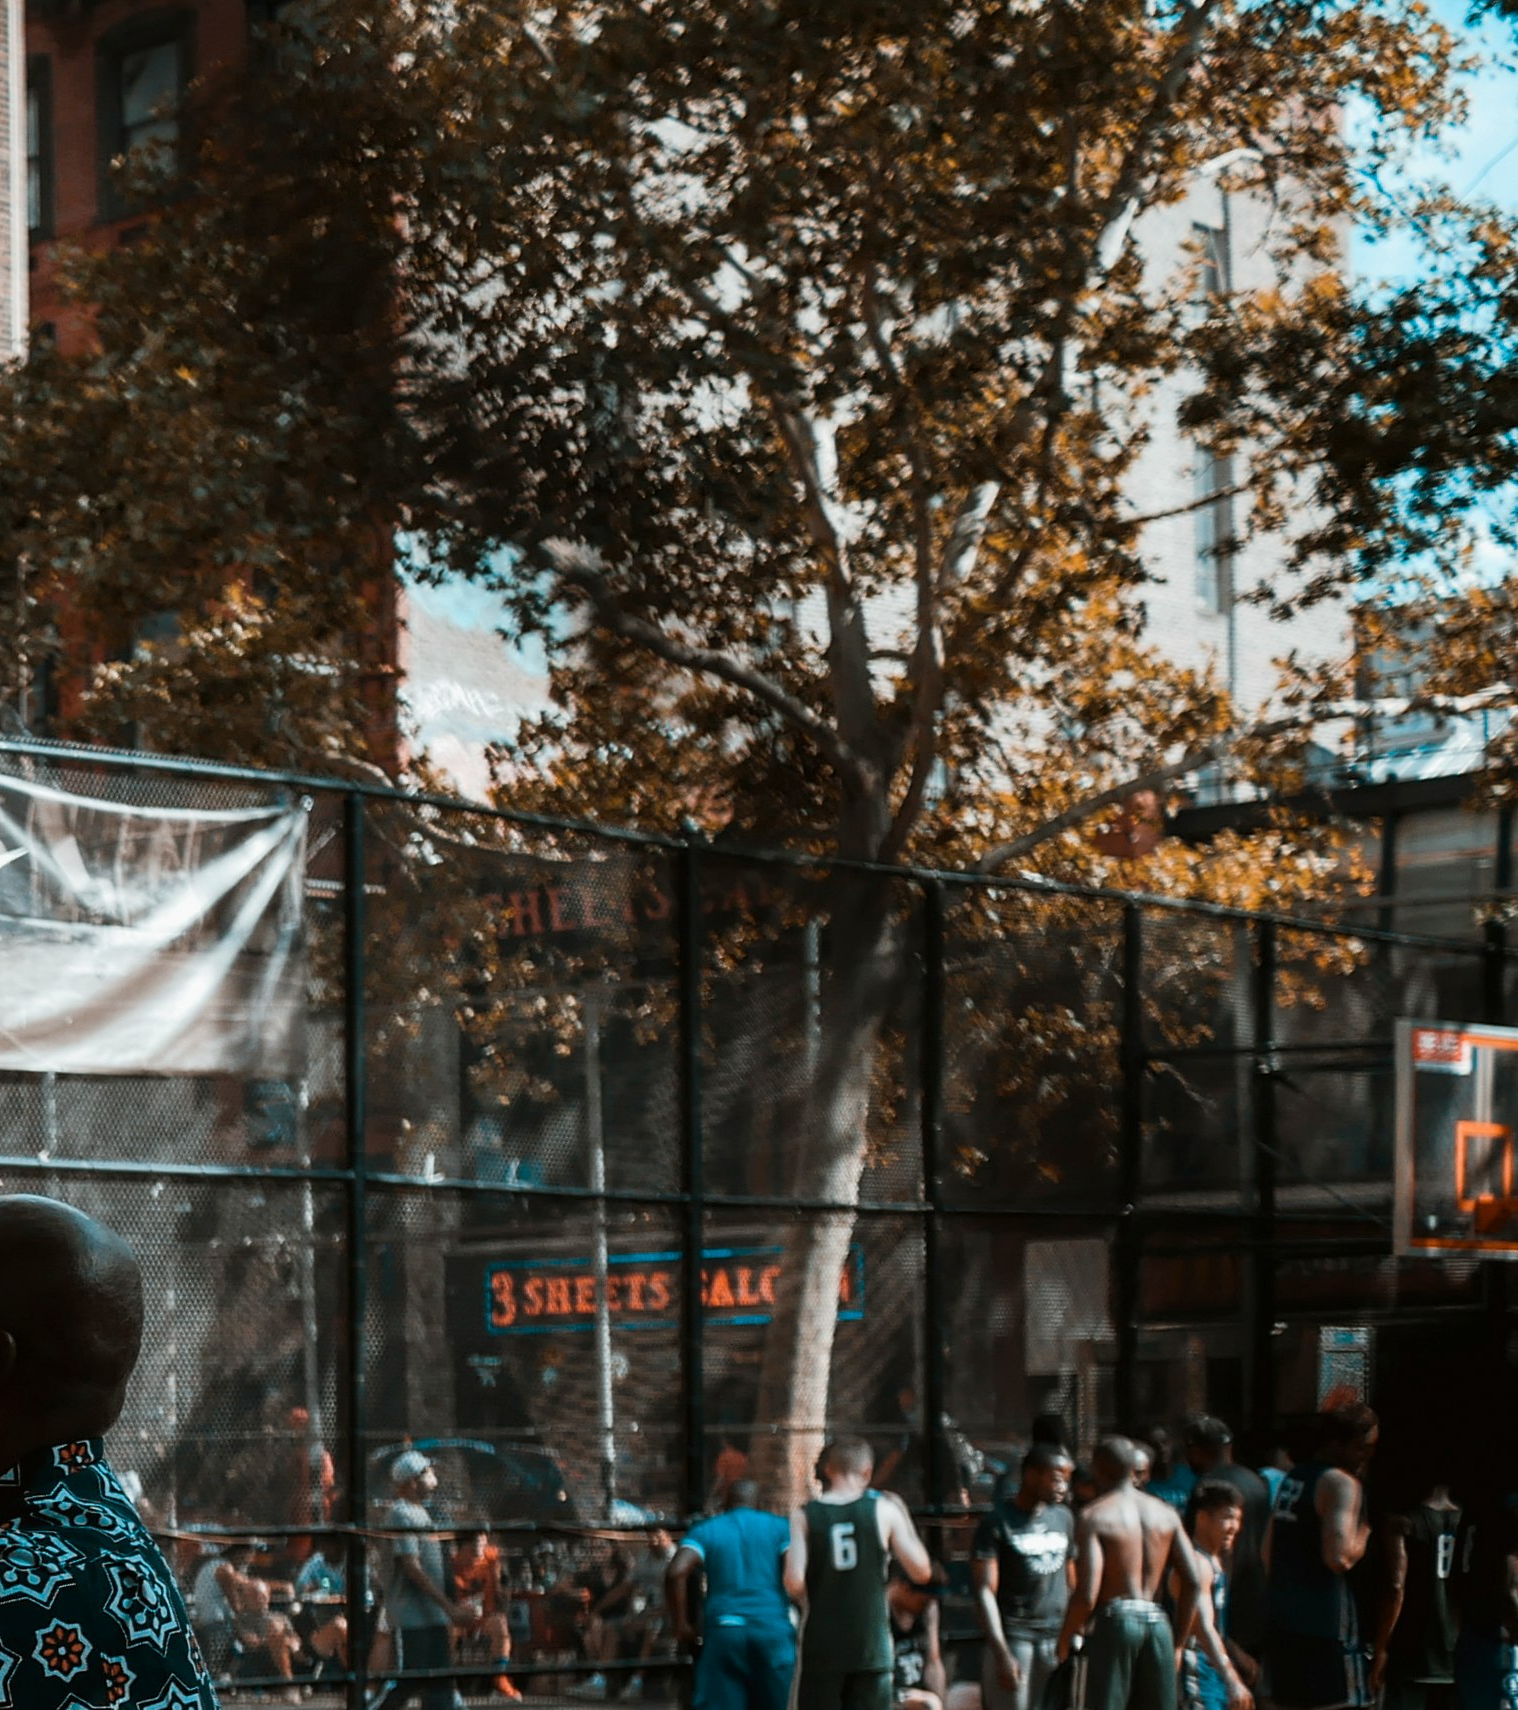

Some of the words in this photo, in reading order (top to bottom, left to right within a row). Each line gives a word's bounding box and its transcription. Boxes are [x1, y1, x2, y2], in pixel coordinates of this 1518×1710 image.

[490, 1271, 517, 1327] 3
[523, 1271, 670, 1316] SHEETS
[830, 1521, 858, 1572] 6
